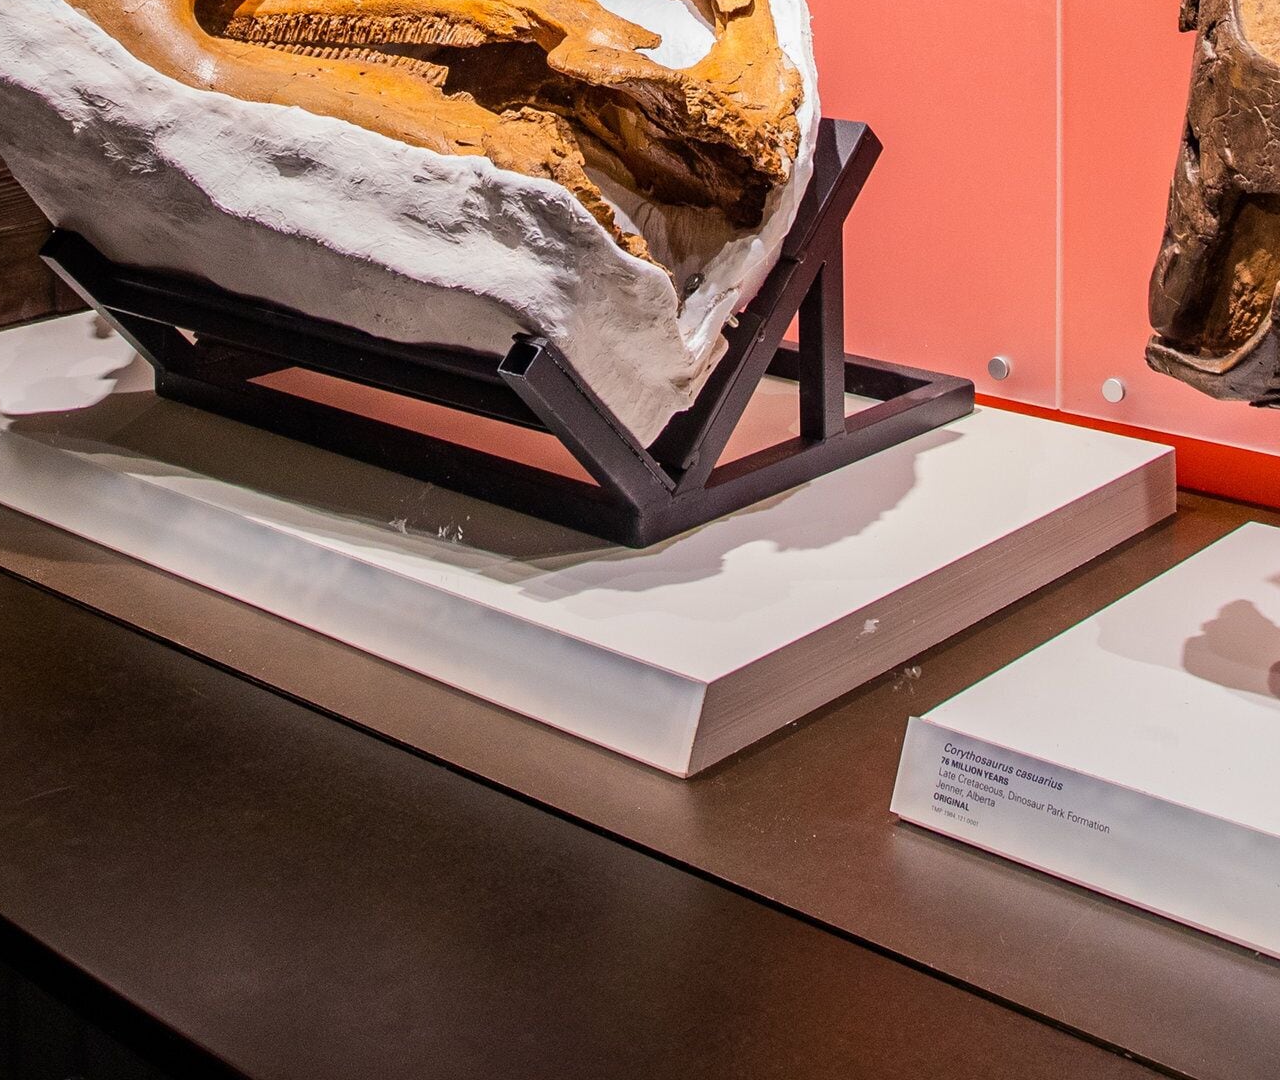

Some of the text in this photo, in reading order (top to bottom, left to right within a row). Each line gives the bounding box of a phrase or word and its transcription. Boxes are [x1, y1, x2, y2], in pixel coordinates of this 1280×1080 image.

[941, 757, 1009, 785] 76 MILLION YEARS
[944, 742, 1063, 791] Corythosaurus casuarius
[934, 792, 970, 811] ORIGINAL
[936, 778, 995, 807] Jenner, Alberta
[939, 767, 1110, 833] Late Cretaceous, Dinosaur Park Formation
